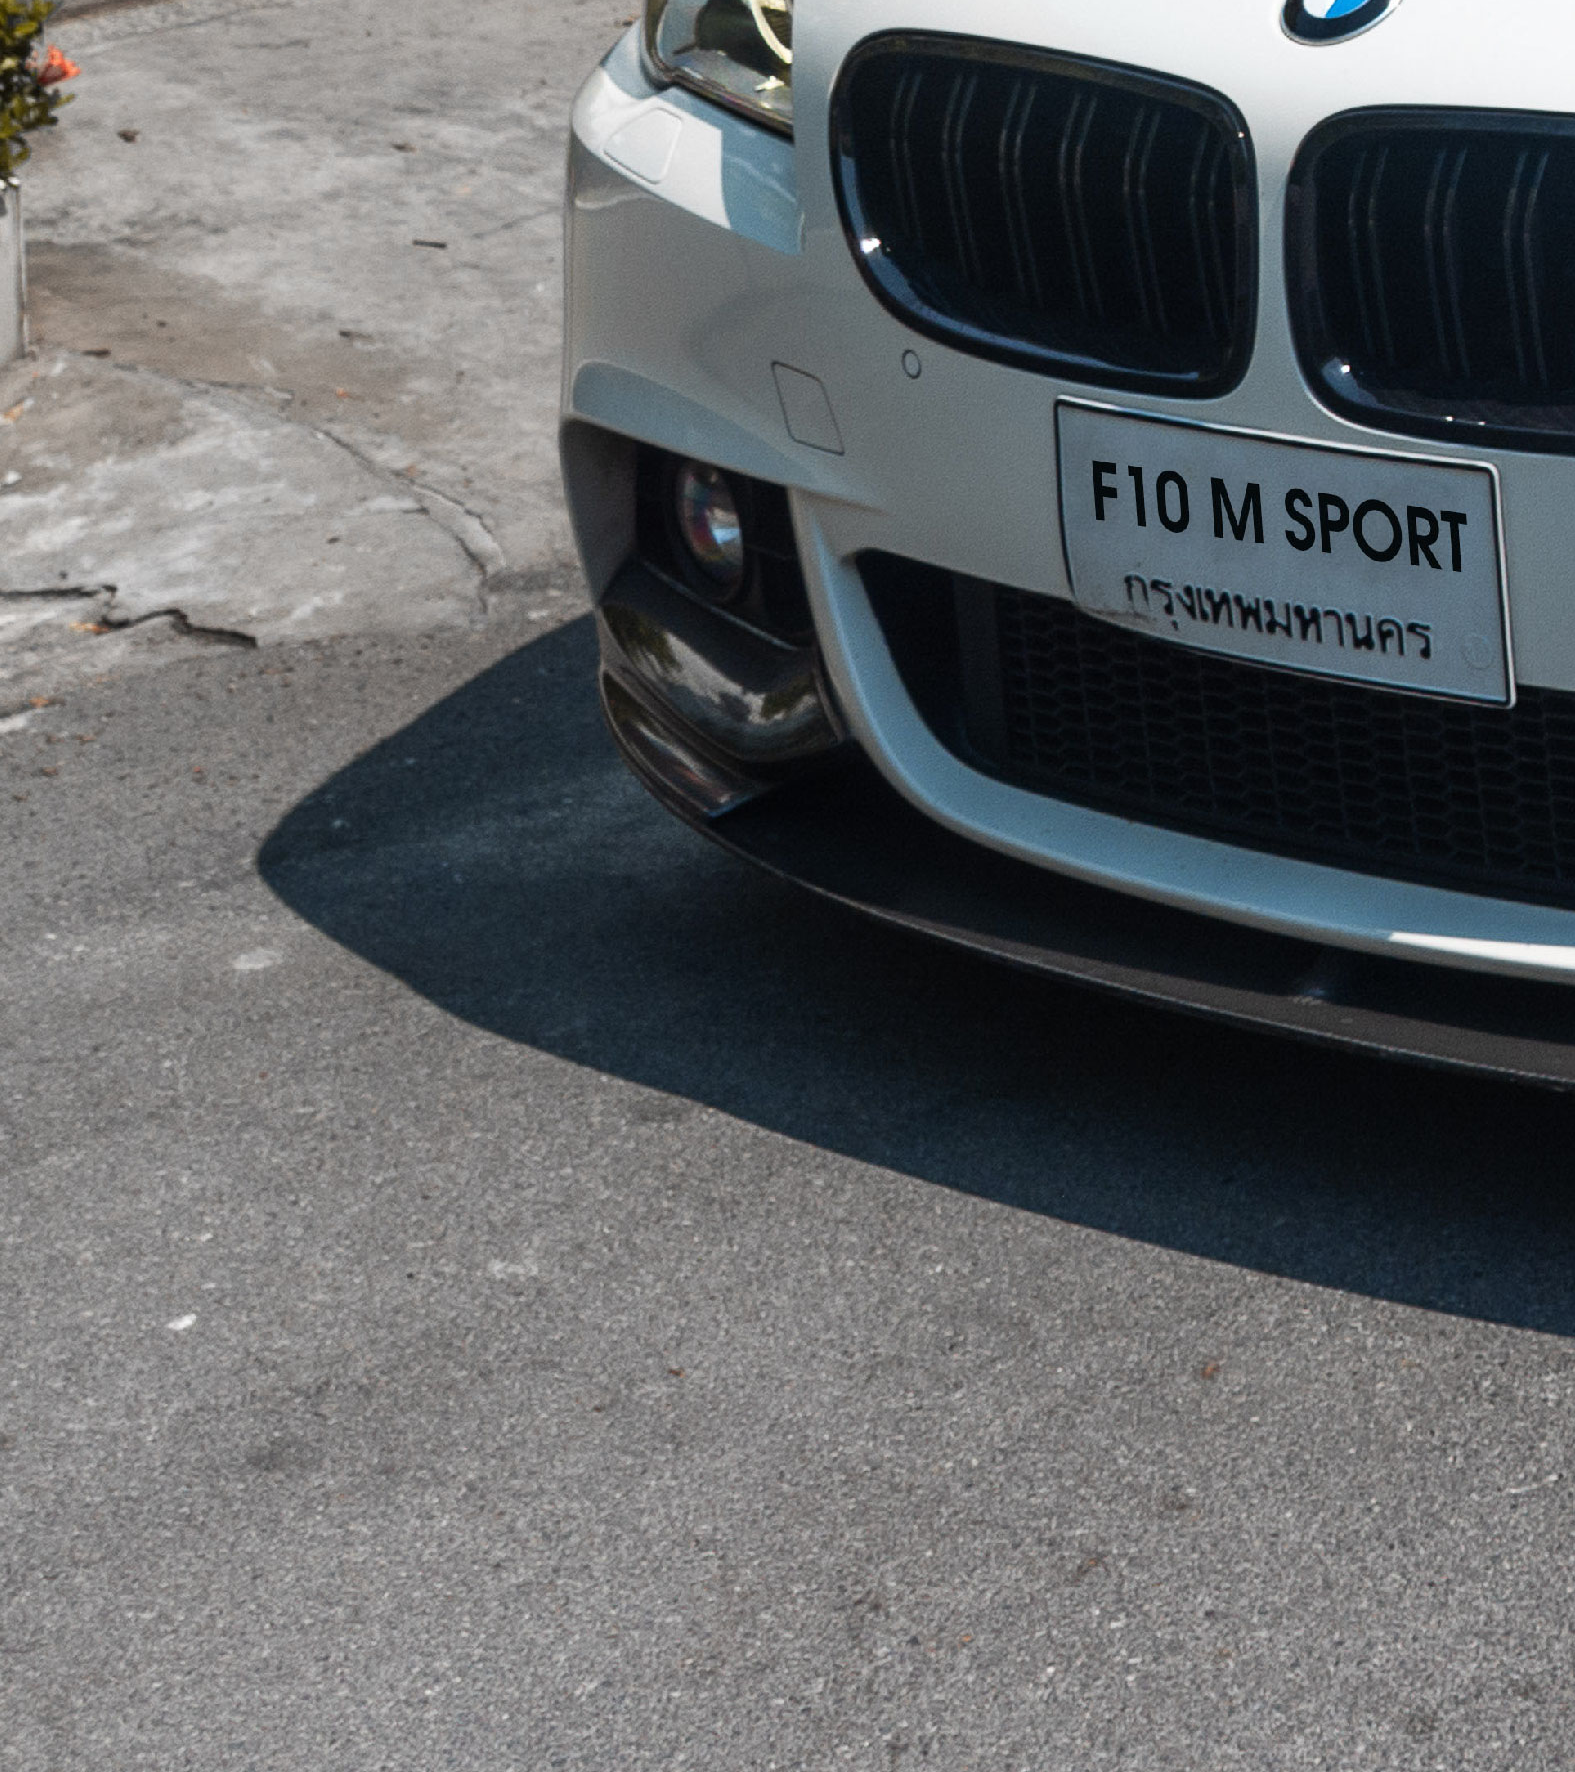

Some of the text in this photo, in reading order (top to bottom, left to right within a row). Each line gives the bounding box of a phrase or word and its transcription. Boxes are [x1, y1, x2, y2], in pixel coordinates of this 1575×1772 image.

[1092, 460, 1468, 573] F10 M SPORT
[1123, 572, 1432, 660] กรุงเทพมหานคร
